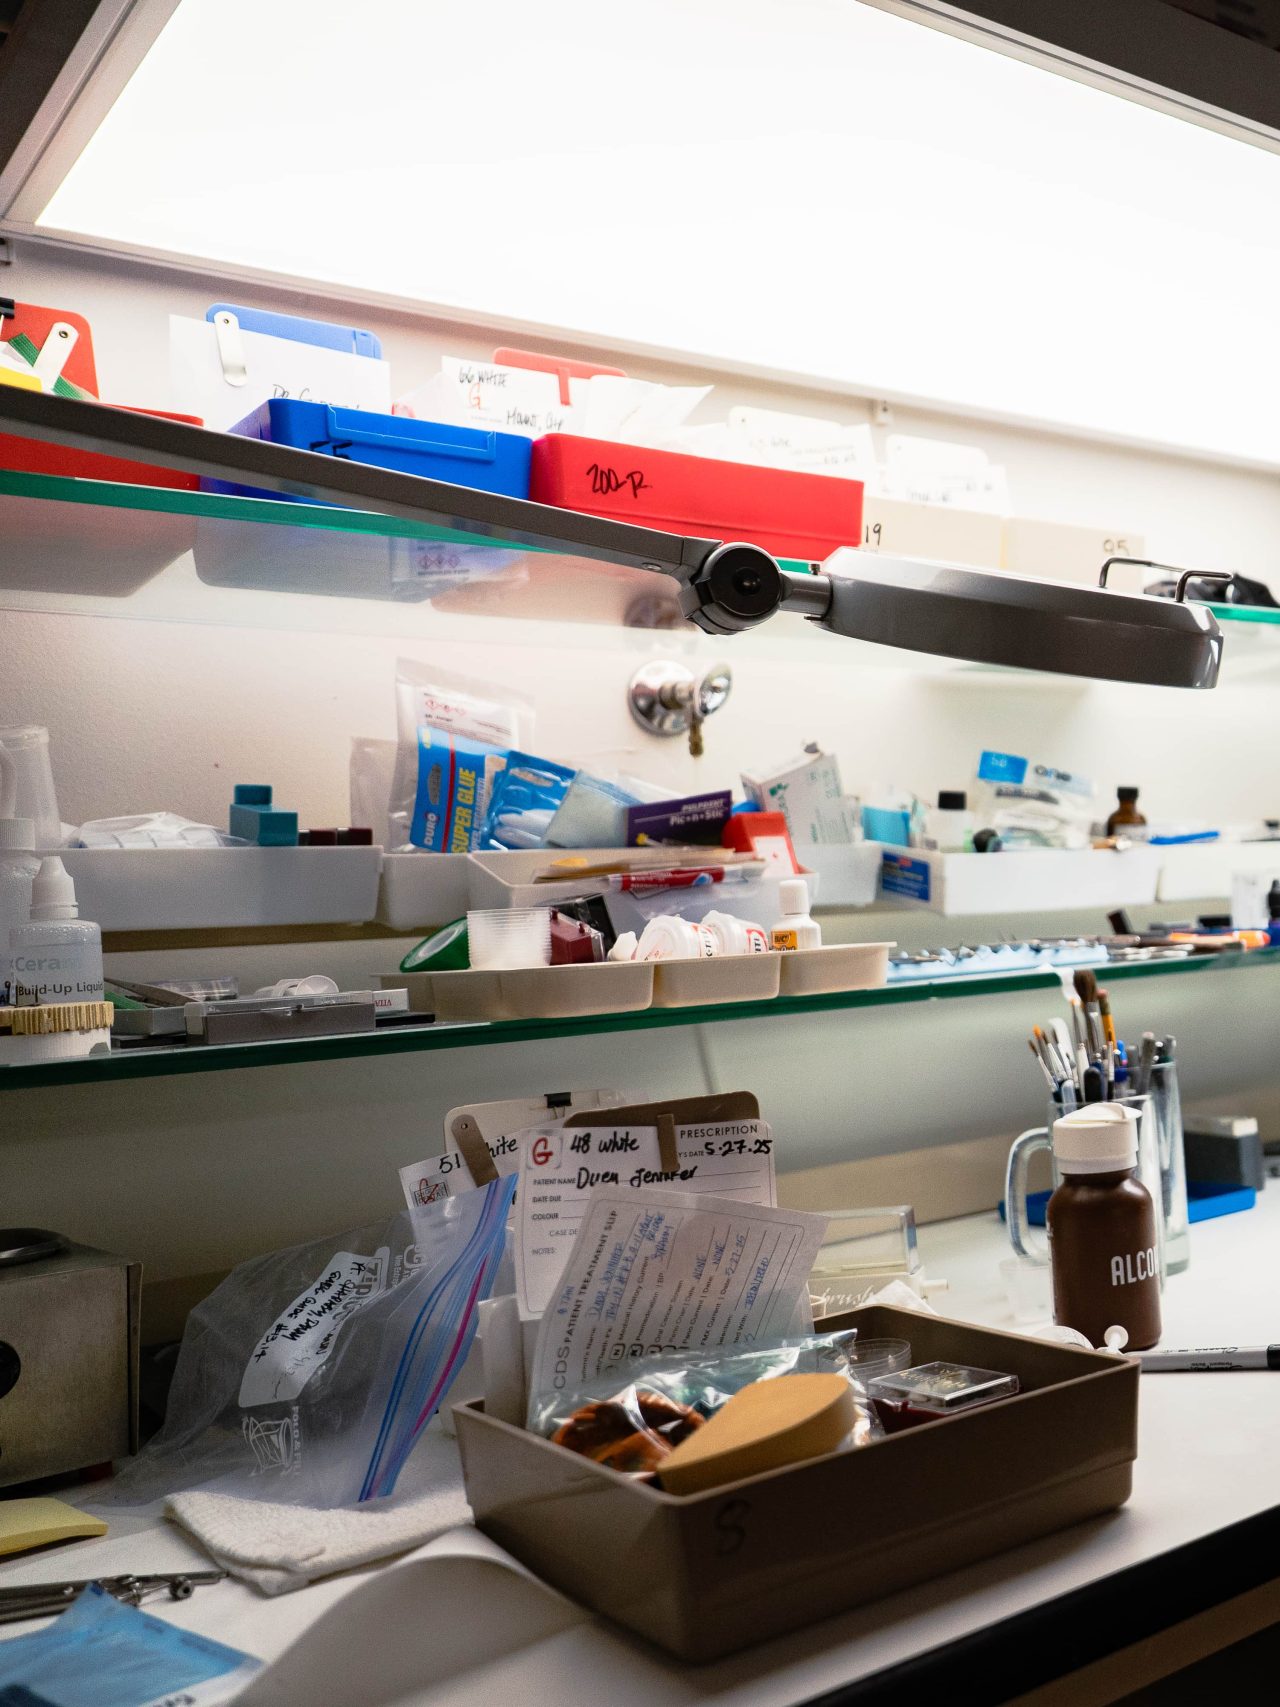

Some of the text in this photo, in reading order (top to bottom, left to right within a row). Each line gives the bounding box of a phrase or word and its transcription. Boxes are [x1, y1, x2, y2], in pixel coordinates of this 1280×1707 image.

[451, 767, 477, 853] SUPER GLUE
[570, 1131, 642, 1154] 48 white
[679, 1124, 759, 1140] PRESCRIPTION
[485, 1137, 520, 1159] hite
[531, 1136, 554, 1166] G
[557, 1177, 576, 1185] NAME
[553, 1346, 570, 1389] CDS
[563, 1299, 582, 1343] PATIENT
[578, 1234, 608, 1295] TREATMENT
[603, 1210, 618, 1231] SLIP
[619, 1311, 631, 1340] Medical
[628, 1286, 642, 1309] History
